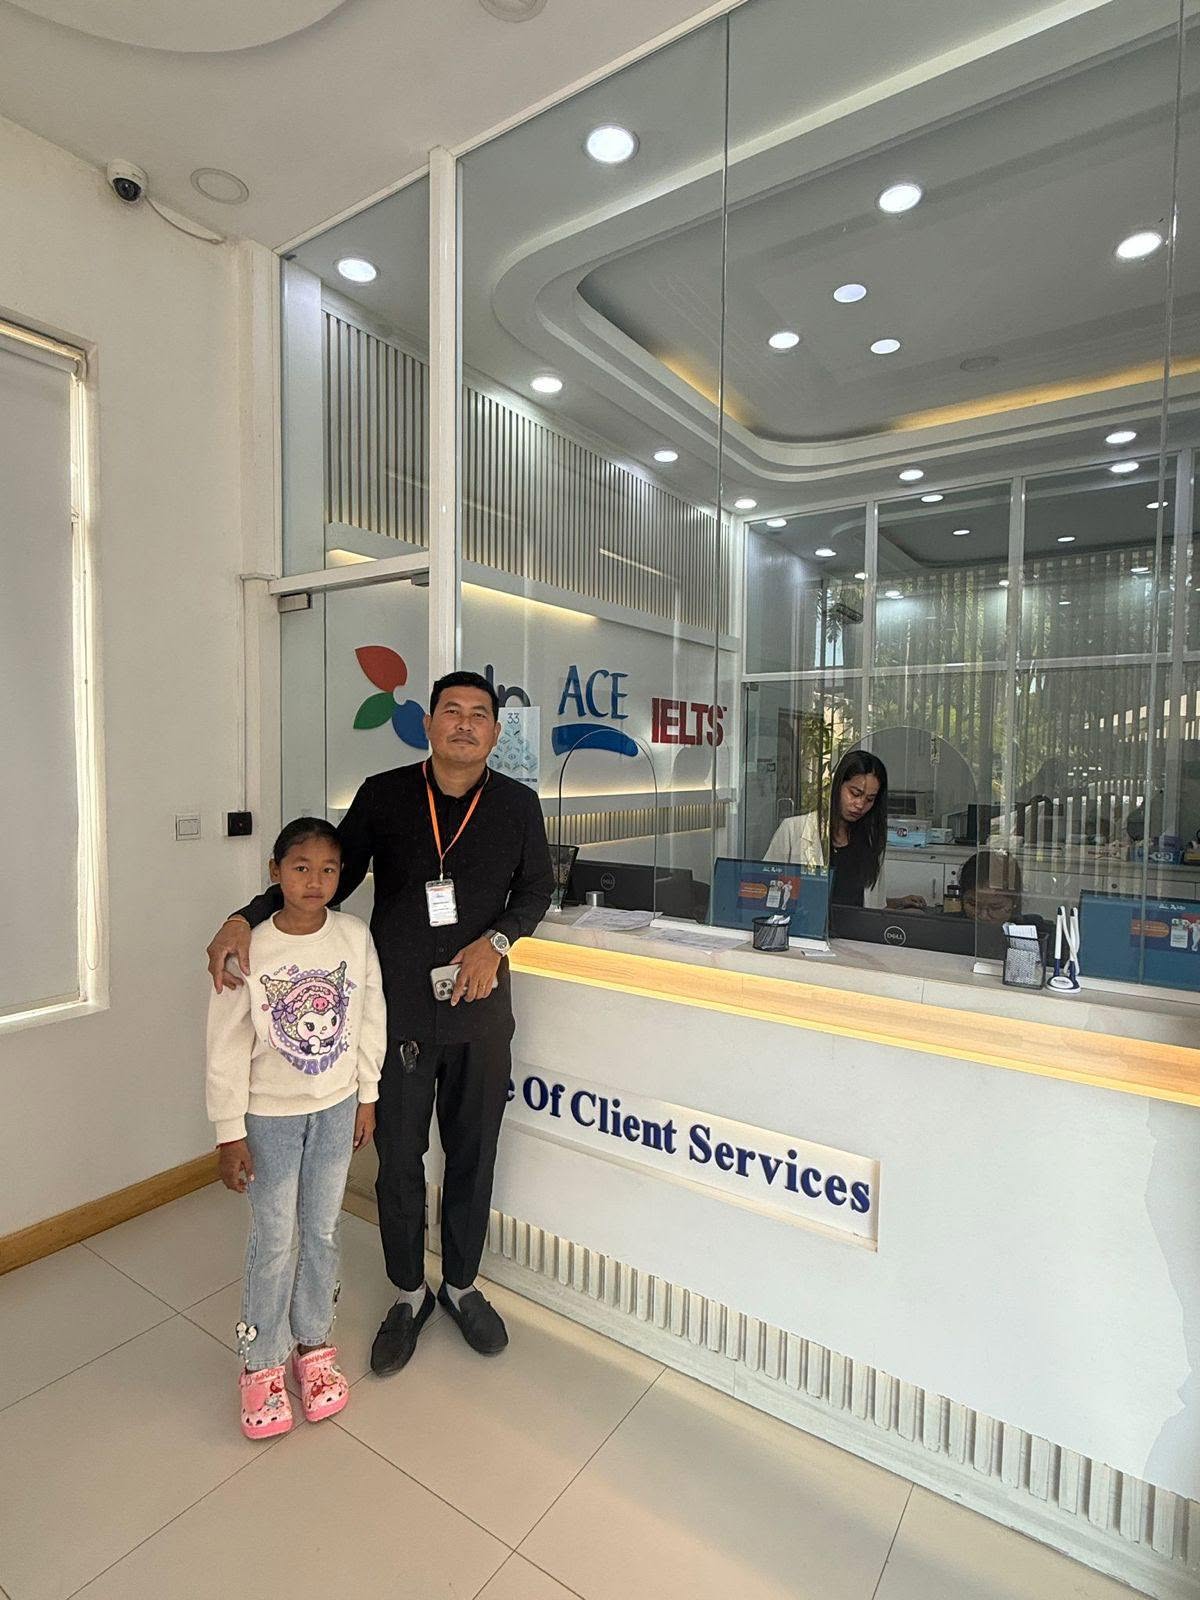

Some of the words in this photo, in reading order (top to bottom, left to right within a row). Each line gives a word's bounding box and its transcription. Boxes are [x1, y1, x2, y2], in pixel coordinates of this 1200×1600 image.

[507, 712, 520, 724] 33
[558, 665, 629, 720] ACE
[651, 697, 725, 747] IELTS
[522, 1076, 566, 1118] Of
[570, 1090, 678, 1155] Client
[689, 1124, 871, 1214] Services
